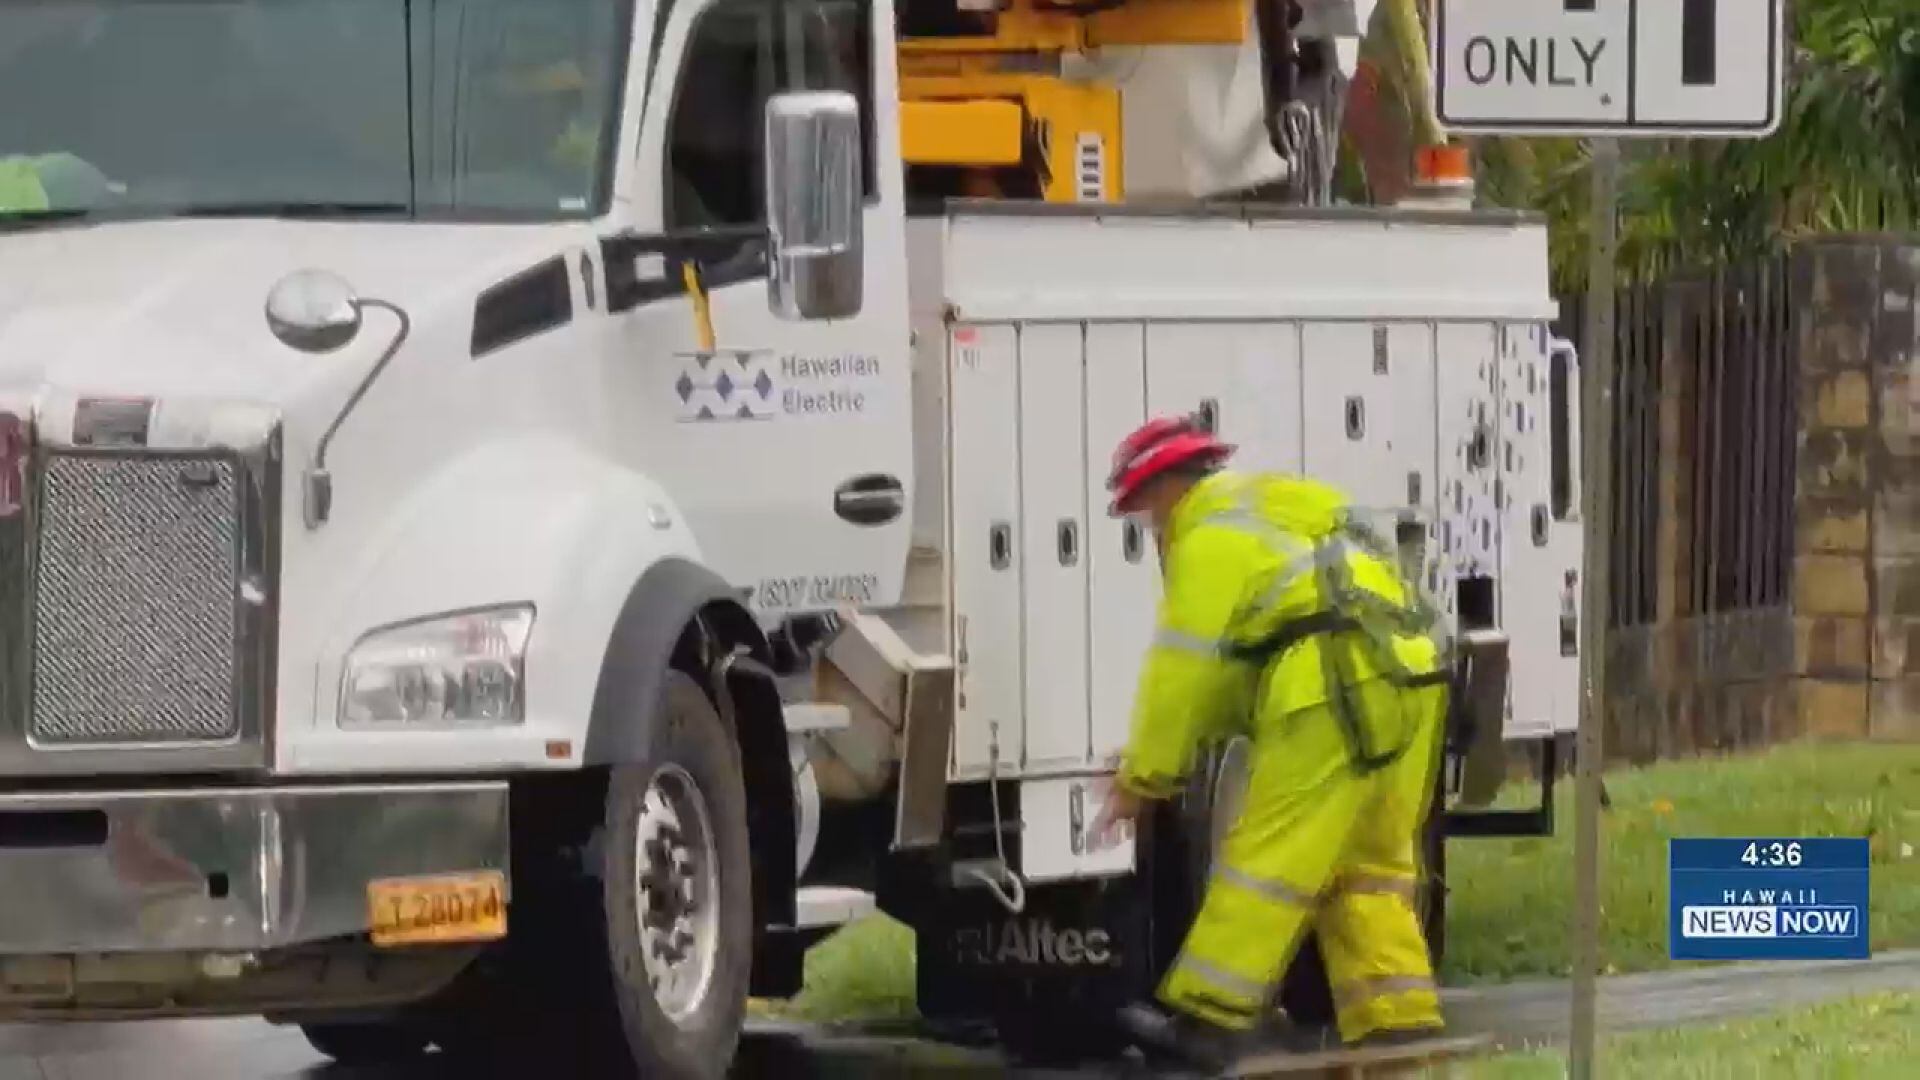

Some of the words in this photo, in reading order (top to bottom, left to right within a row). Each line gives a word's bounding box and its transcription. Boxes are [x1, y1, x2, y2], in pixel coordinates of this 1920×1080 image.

[1463, 35, 1607, 87] ONLY
[780, 354, 880, 378] Hawaiian
[781, 388, 866, 414] Electric
